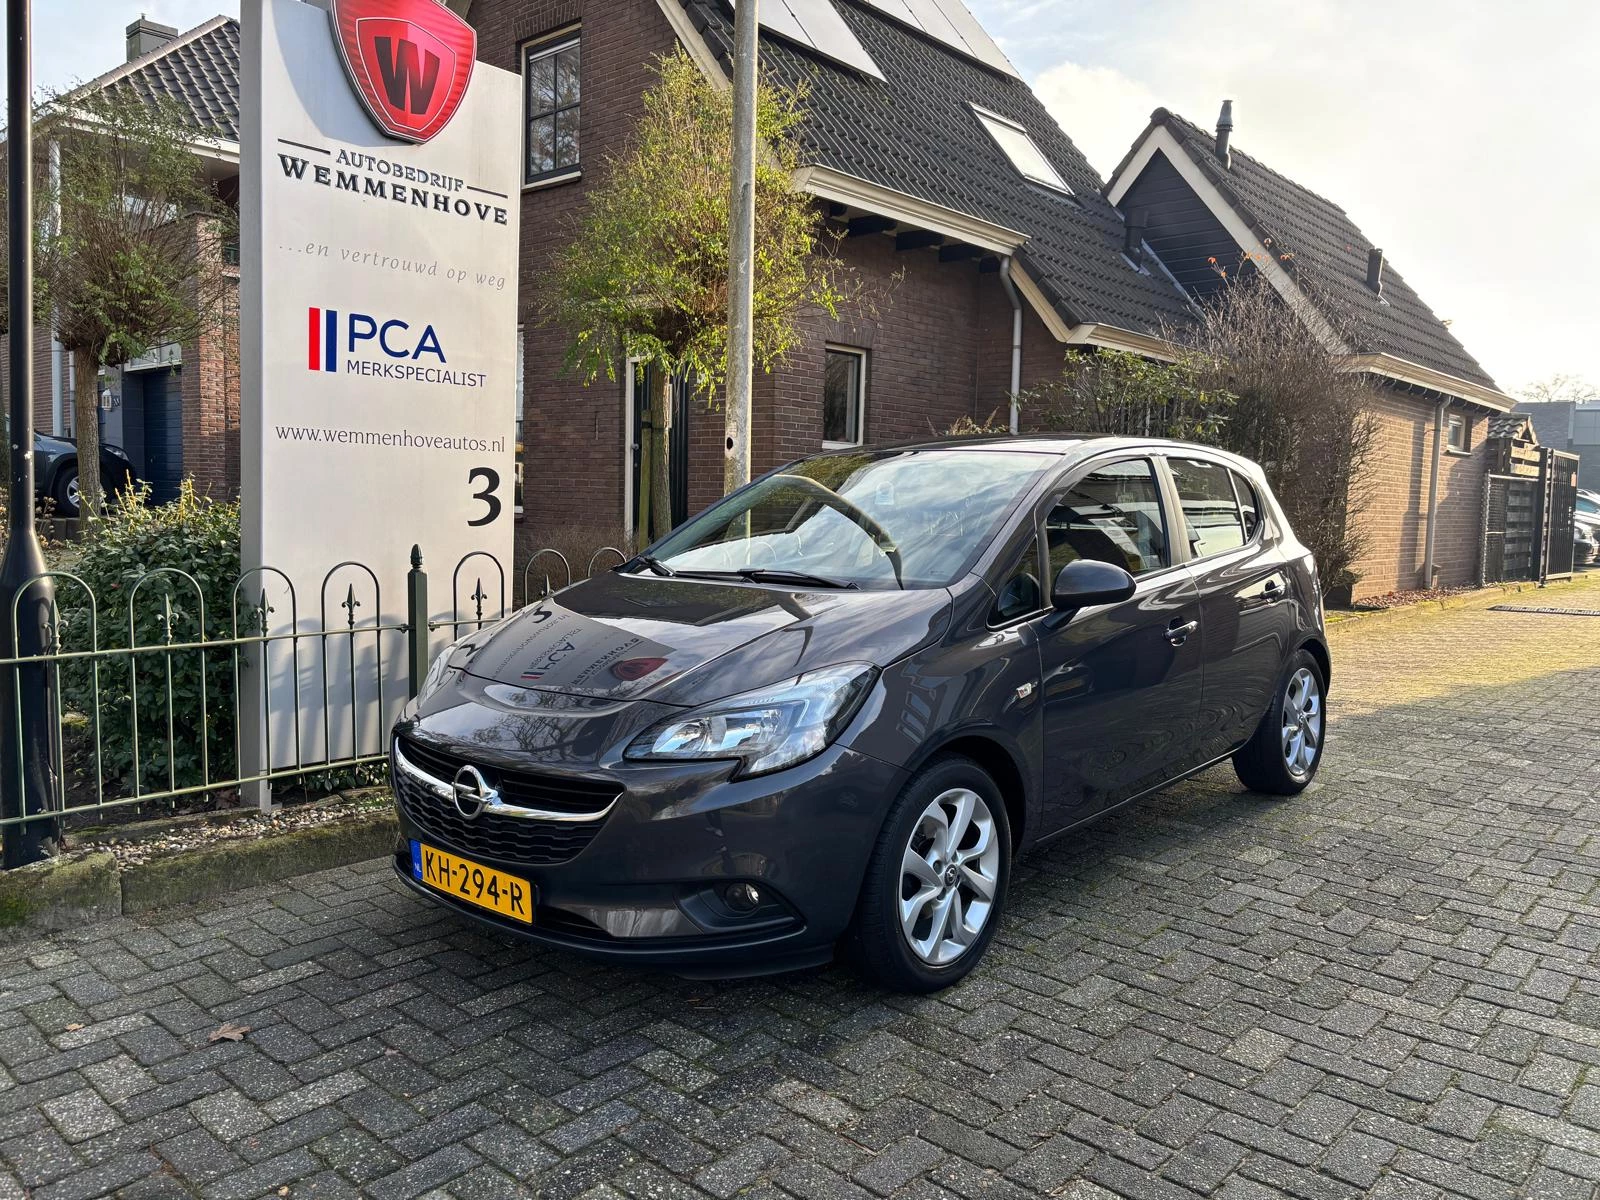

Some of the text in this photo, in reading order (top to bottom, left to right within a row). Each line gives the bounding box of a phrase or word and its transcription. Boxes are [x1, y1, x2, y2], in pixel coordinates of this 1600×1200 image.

[374, 36, 440, 115] W
[277, 153, 508, 225] WEMMENHOVE
[336, 149, 464, 192] AUTOBEDRIJF
[341, 249, 438, 276] vertrouwd
[446, 267, 467, 282] op
[476, 273, 506, 290] weg
[348, 313, 447, 364] PCA
[347, 360, 487, 387] MERKSPECIALIST
[275, 425, 505, 452] www.wemmenhoveautos.nl
[466, 466, 502, 527] 3
[424, 849, 525, 915] KH-294-R
